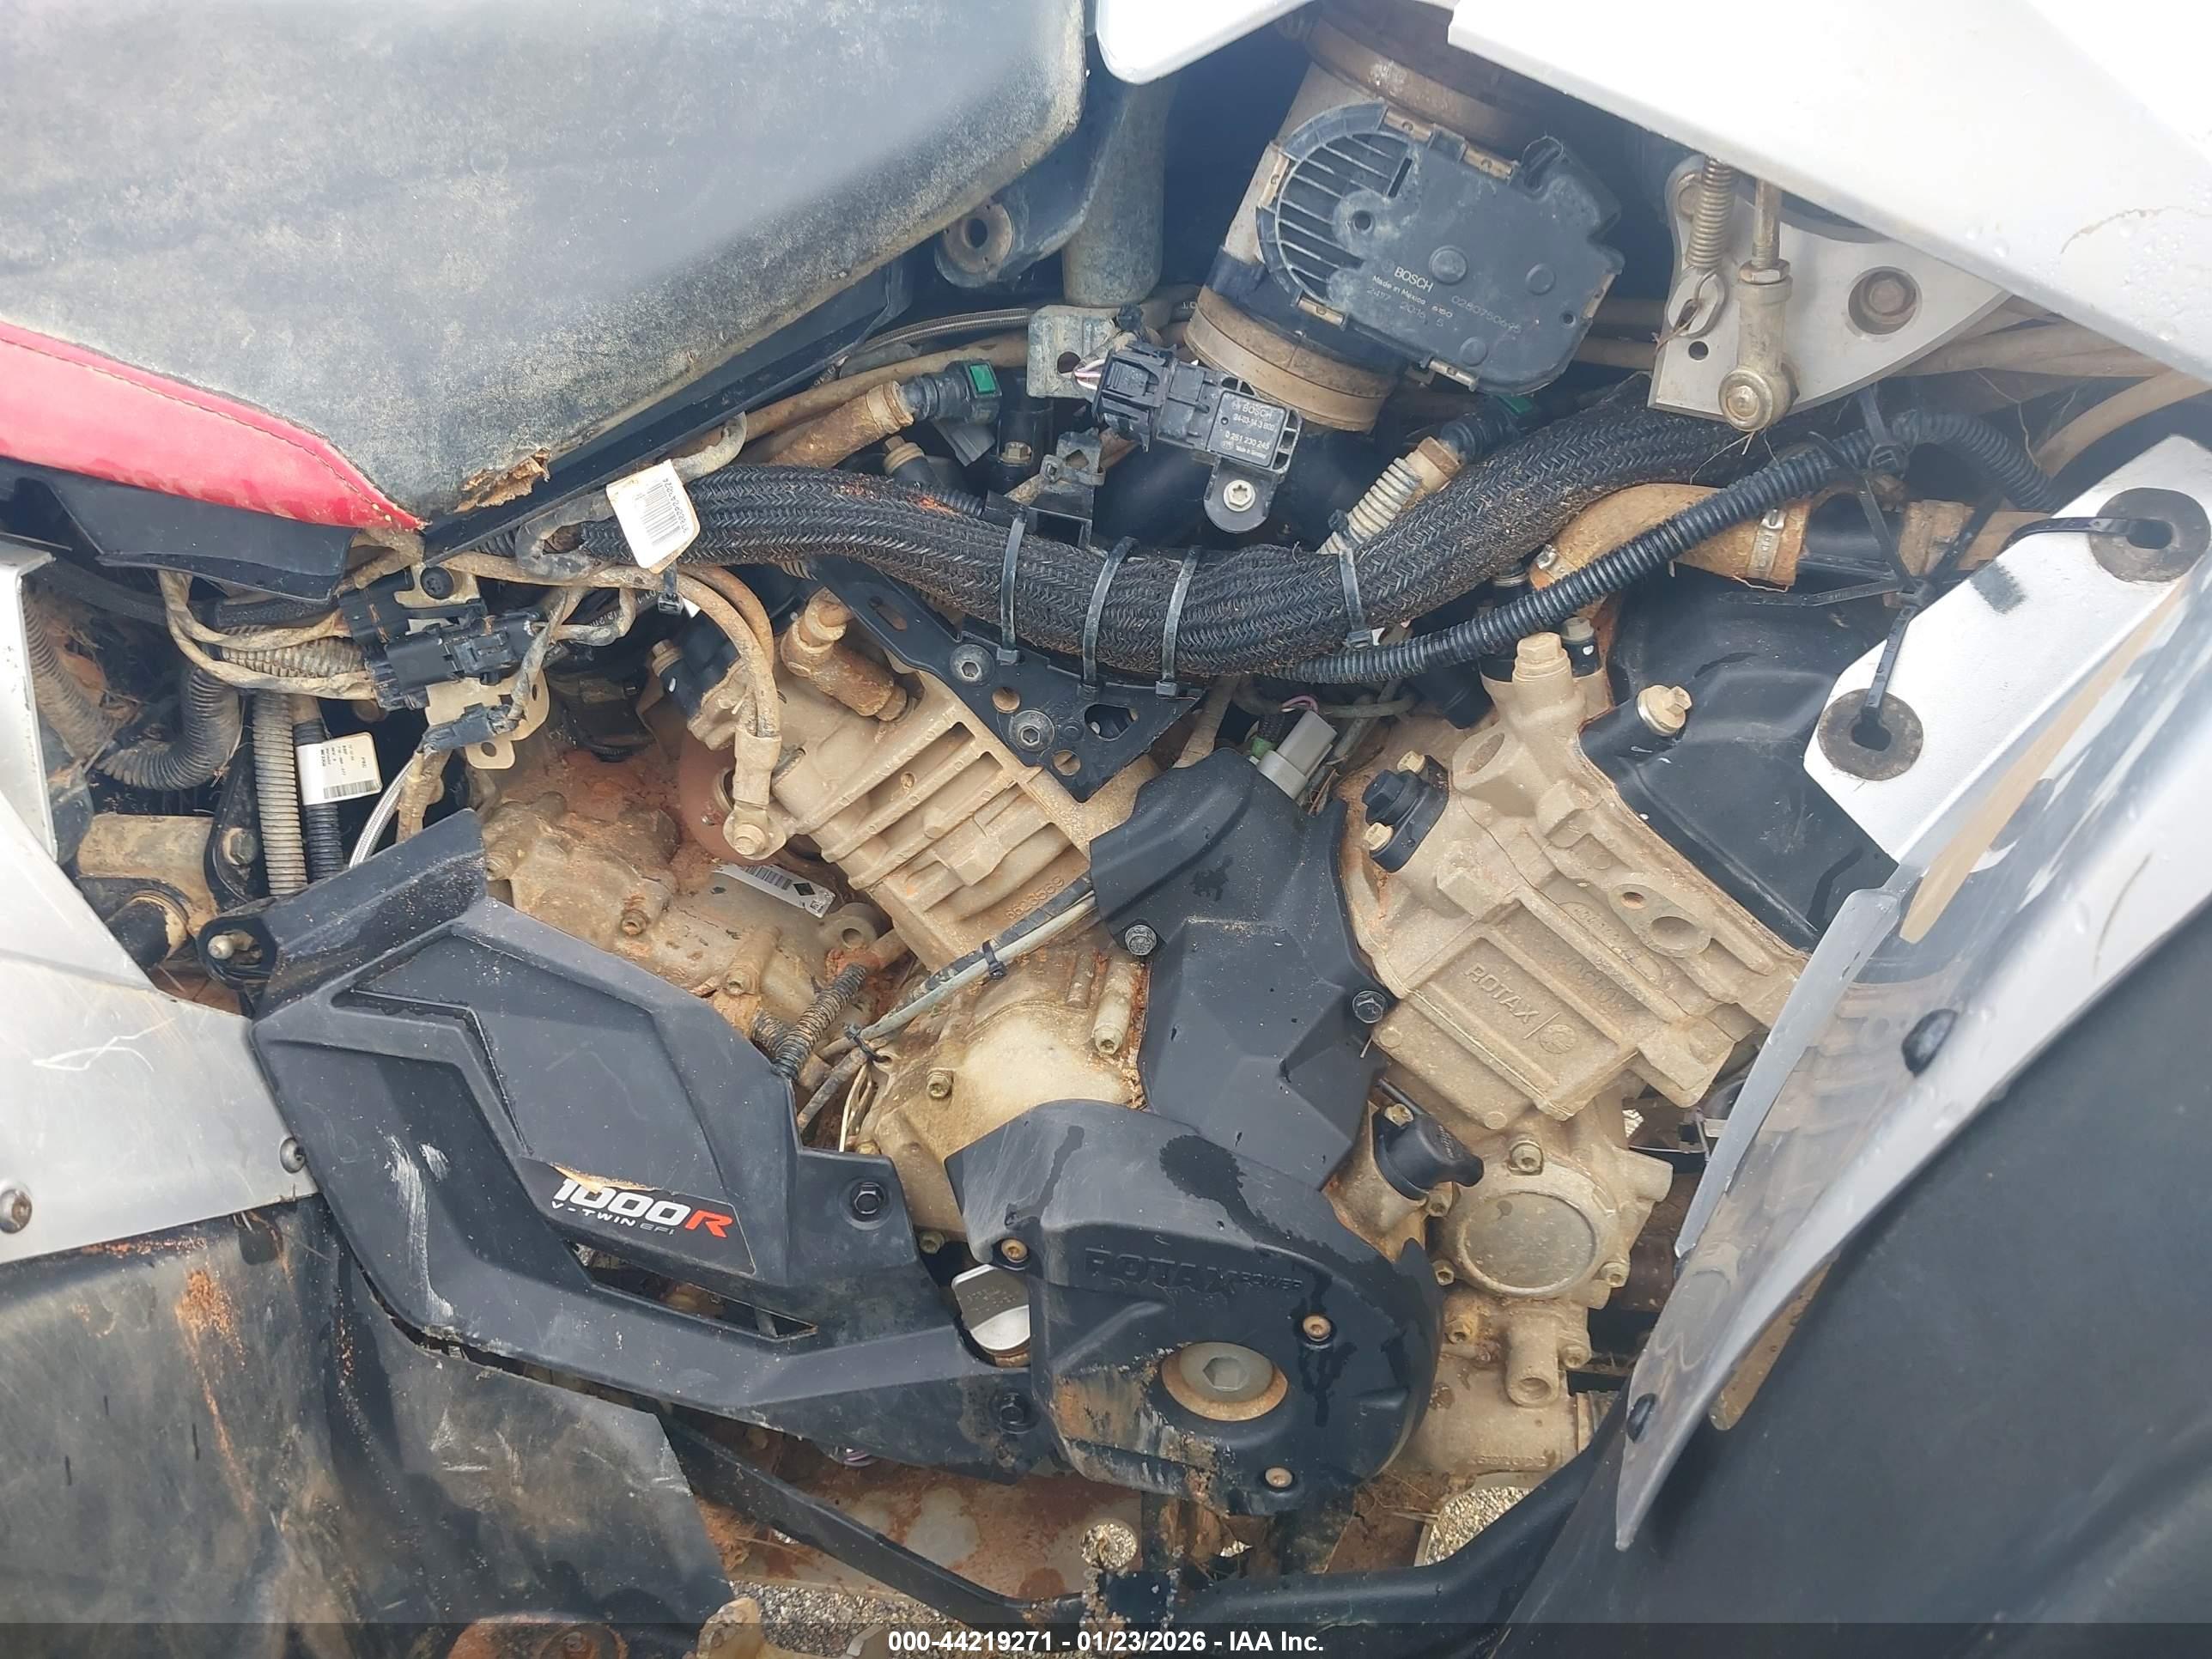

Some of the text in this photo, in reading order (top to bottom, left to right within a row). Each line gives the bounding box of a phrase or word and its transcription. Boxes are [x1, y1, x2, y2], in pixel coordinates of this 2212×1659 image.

[1372, 274, 1393, 290] Made
[1400, 287, 1427, 306] Mexico
[1394, 265, 1434, 293] BOSCH
[1243, 404, 1273, 419] BOSCH
[1463, 962, 1540, 1024] ROTAX
[1085, 1247, 1237, 1295] ROTAX
